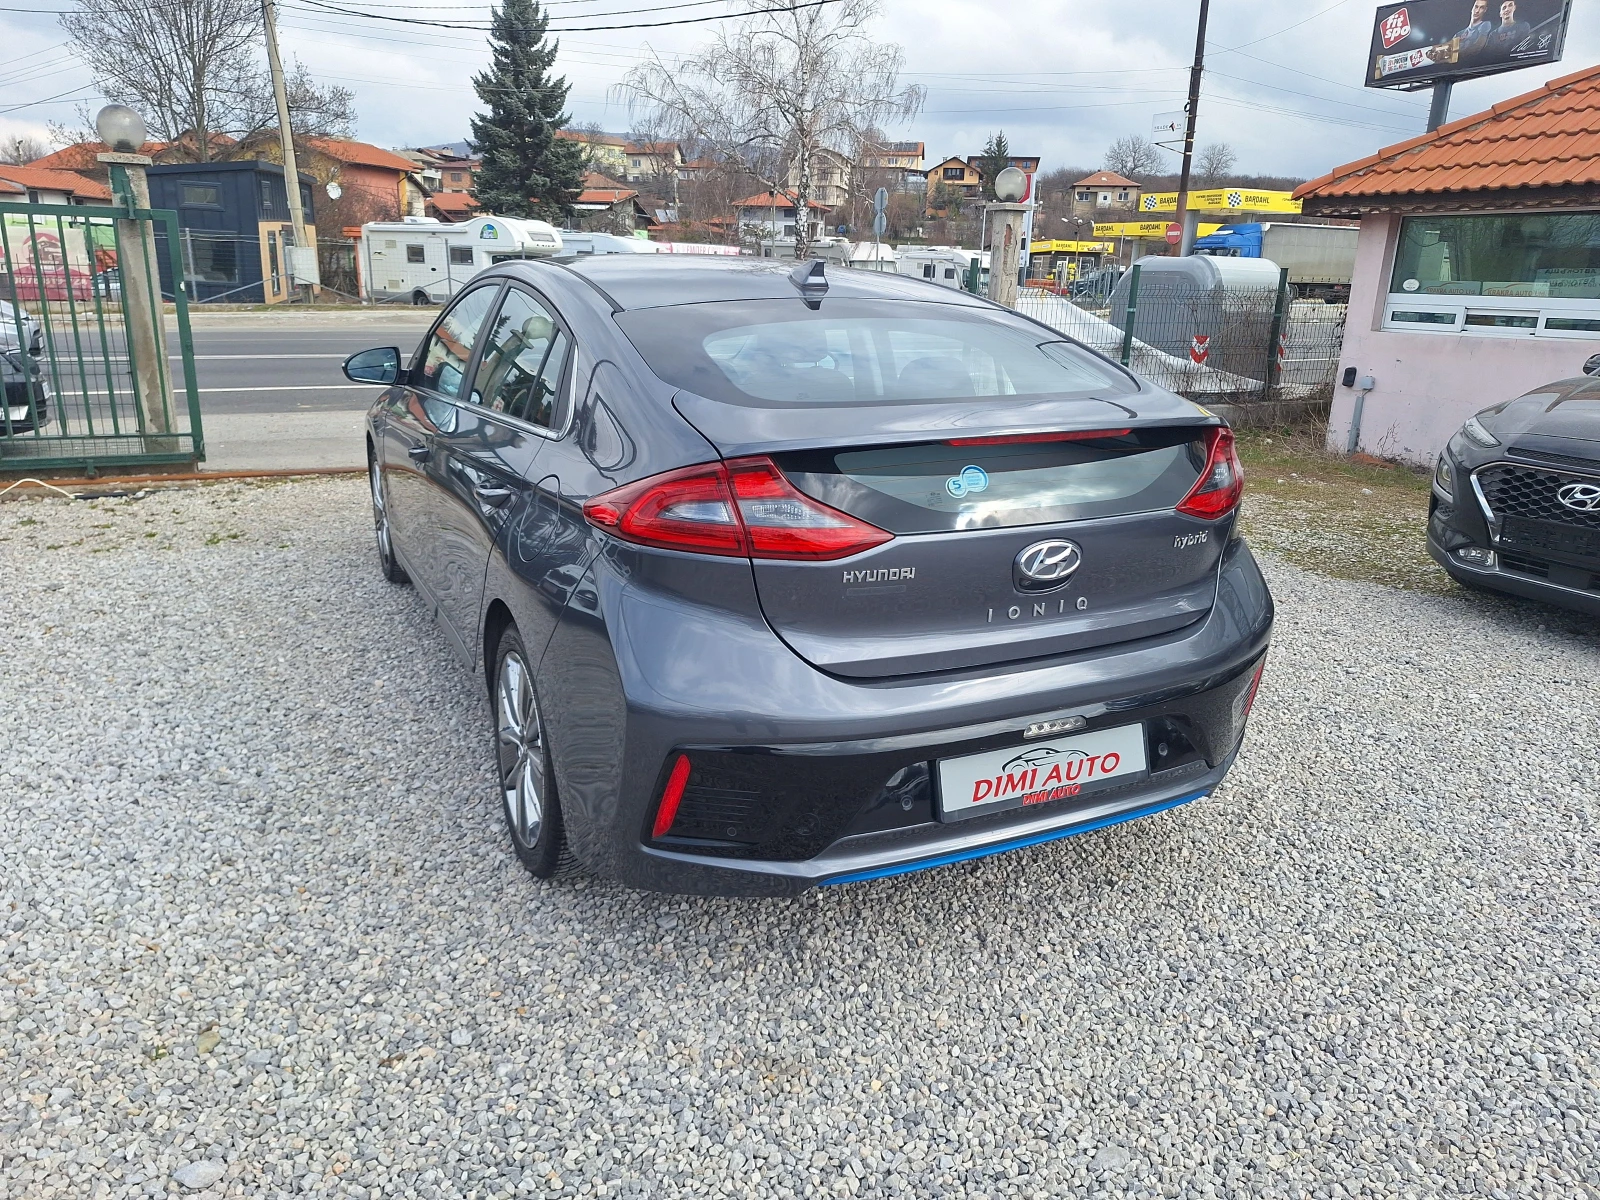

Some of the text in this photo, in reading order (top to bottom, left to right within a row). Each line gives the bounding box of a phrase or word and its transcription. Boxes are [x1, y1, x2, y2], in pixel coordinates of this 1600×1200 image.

[1386, 14, 1405, 29] fit
[1384, 25, 1410, 42] spo
[1245, 195, 1270, 206] BARDAHL
[1095, 225, 1115, 233] BARDAHL
[1140, 223, 1161, 233] BARDAHL
[1173, 530, 1209, 549] hybrid
[842, 567, 916, 583] HYUNDAI
[987, 597, 1088, 623] IONIQ
[972, 752, 1121, 802] DIMI AUTO
[1022, 784, 1081, 806] DIMI AUTO
